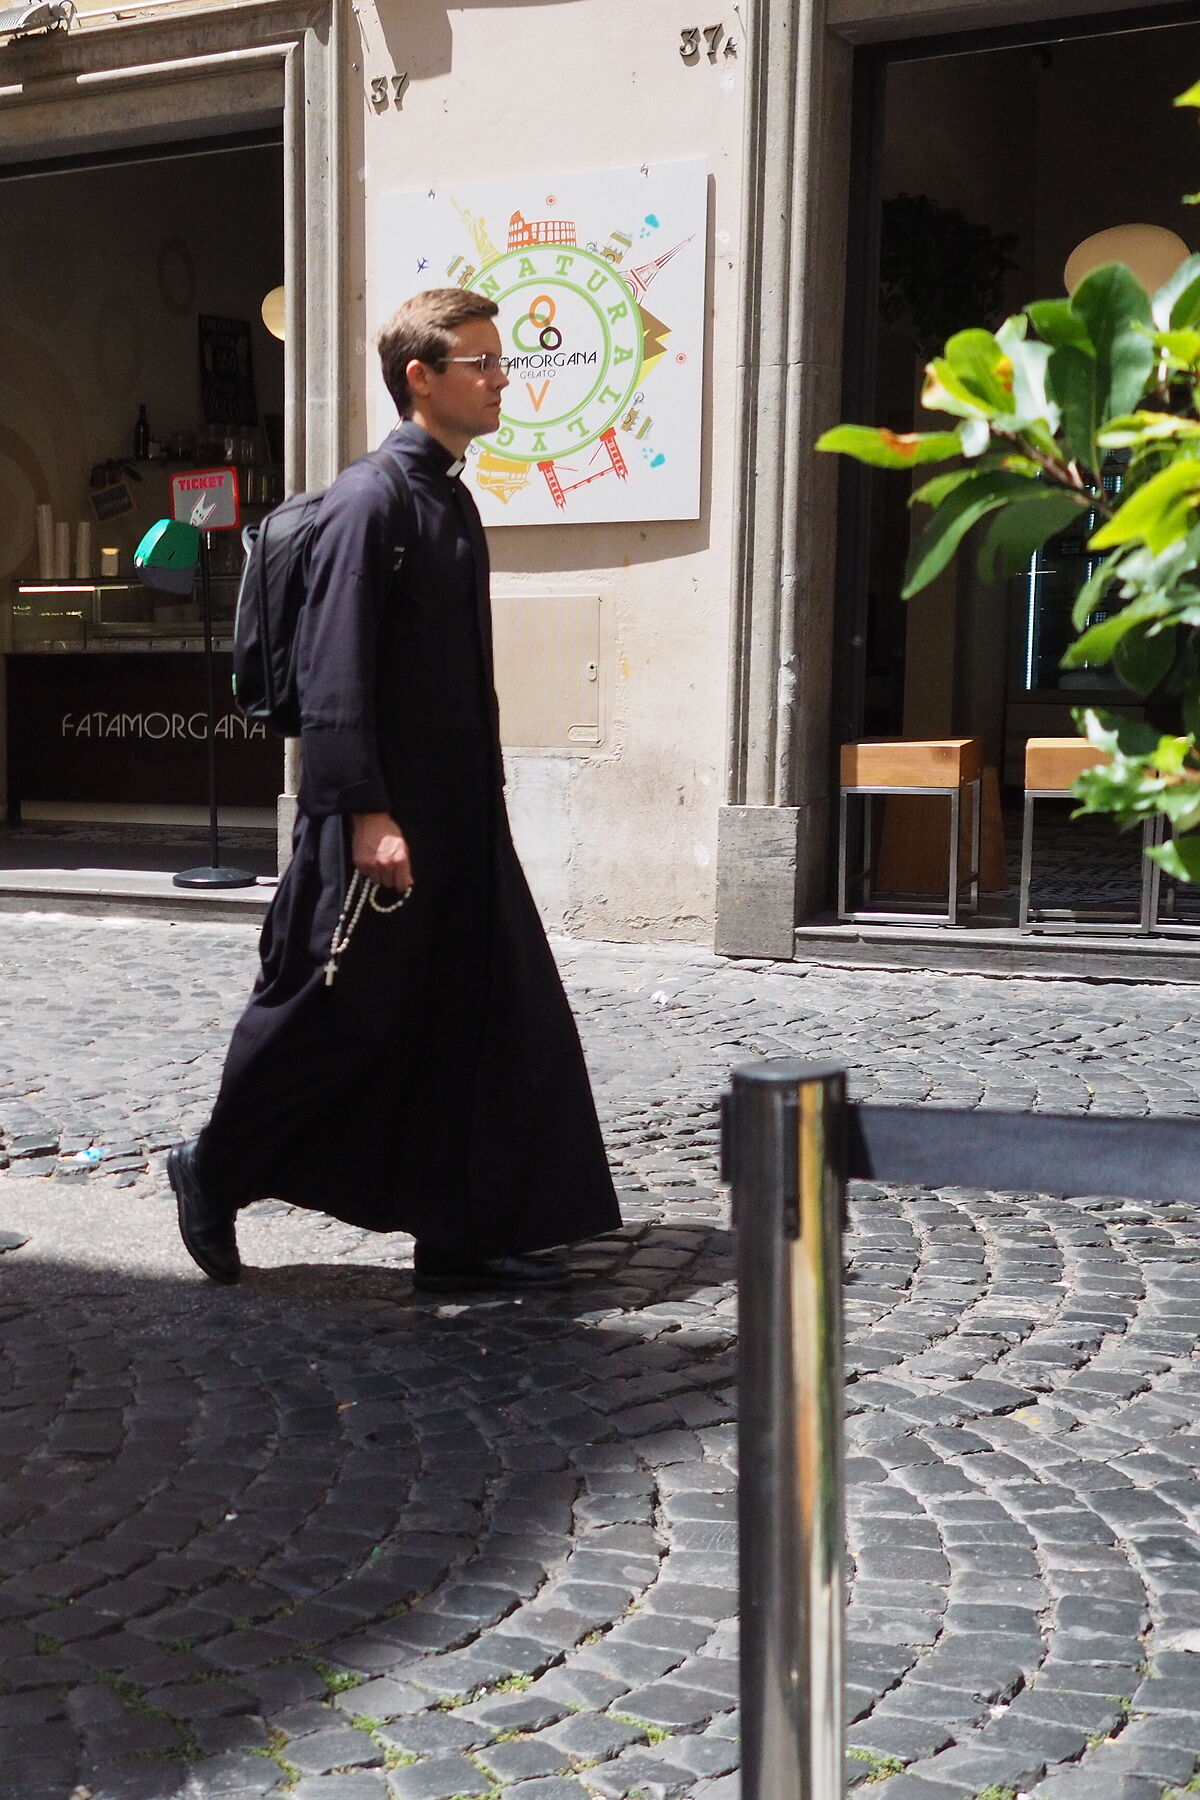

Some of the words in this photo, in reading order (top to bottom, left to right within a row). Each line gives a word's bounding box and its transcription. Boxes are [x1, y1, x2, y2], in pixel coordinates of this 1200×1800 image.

[371, 72, 408, 104] 37
[501, 351, 597, 370] AMORGANA
[519, 368, 557, 380] GELATO
[178, 475, 224, 491] TICKET
[62, 712, 266, 739] FATAMORGANA
